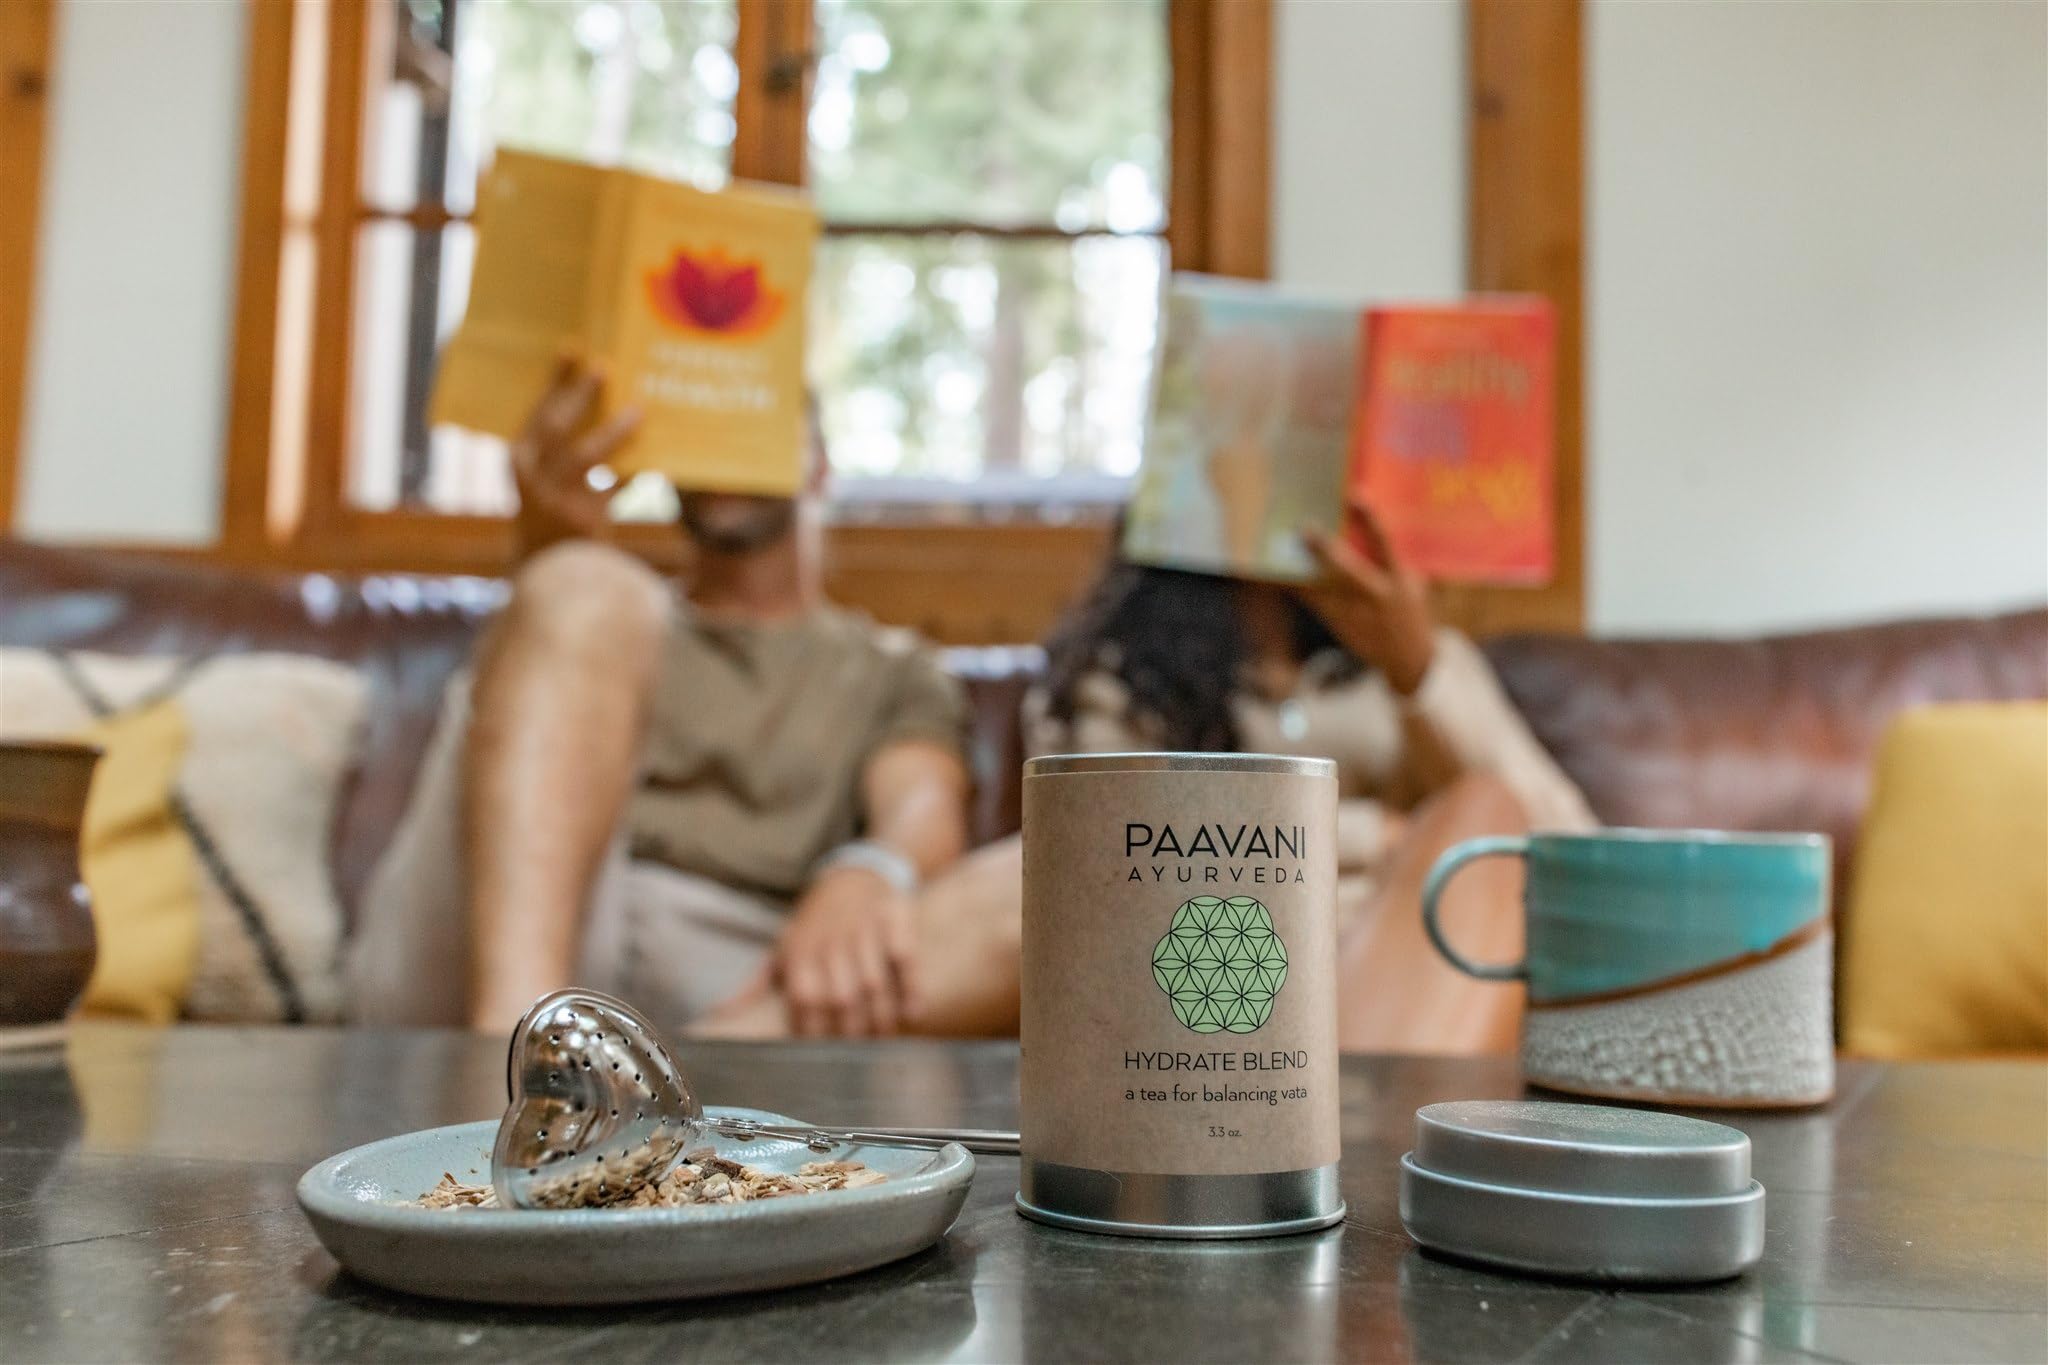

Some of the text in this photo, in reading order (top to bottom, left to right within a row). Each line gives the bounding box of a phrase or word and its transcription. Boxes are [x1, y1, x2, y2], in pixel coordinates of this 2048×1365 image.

[1125, 823, 1306, 860] PAAVANI
[1127, 865, 1305, 884] AYURVEDA
[1124, 1050, 1308, 1072] HYDRATE BLEND
[1125, 1083, 1308, 1107] a tea for balancing vata
[1208, 1125, 1243, 1138] 3.3 oz.
